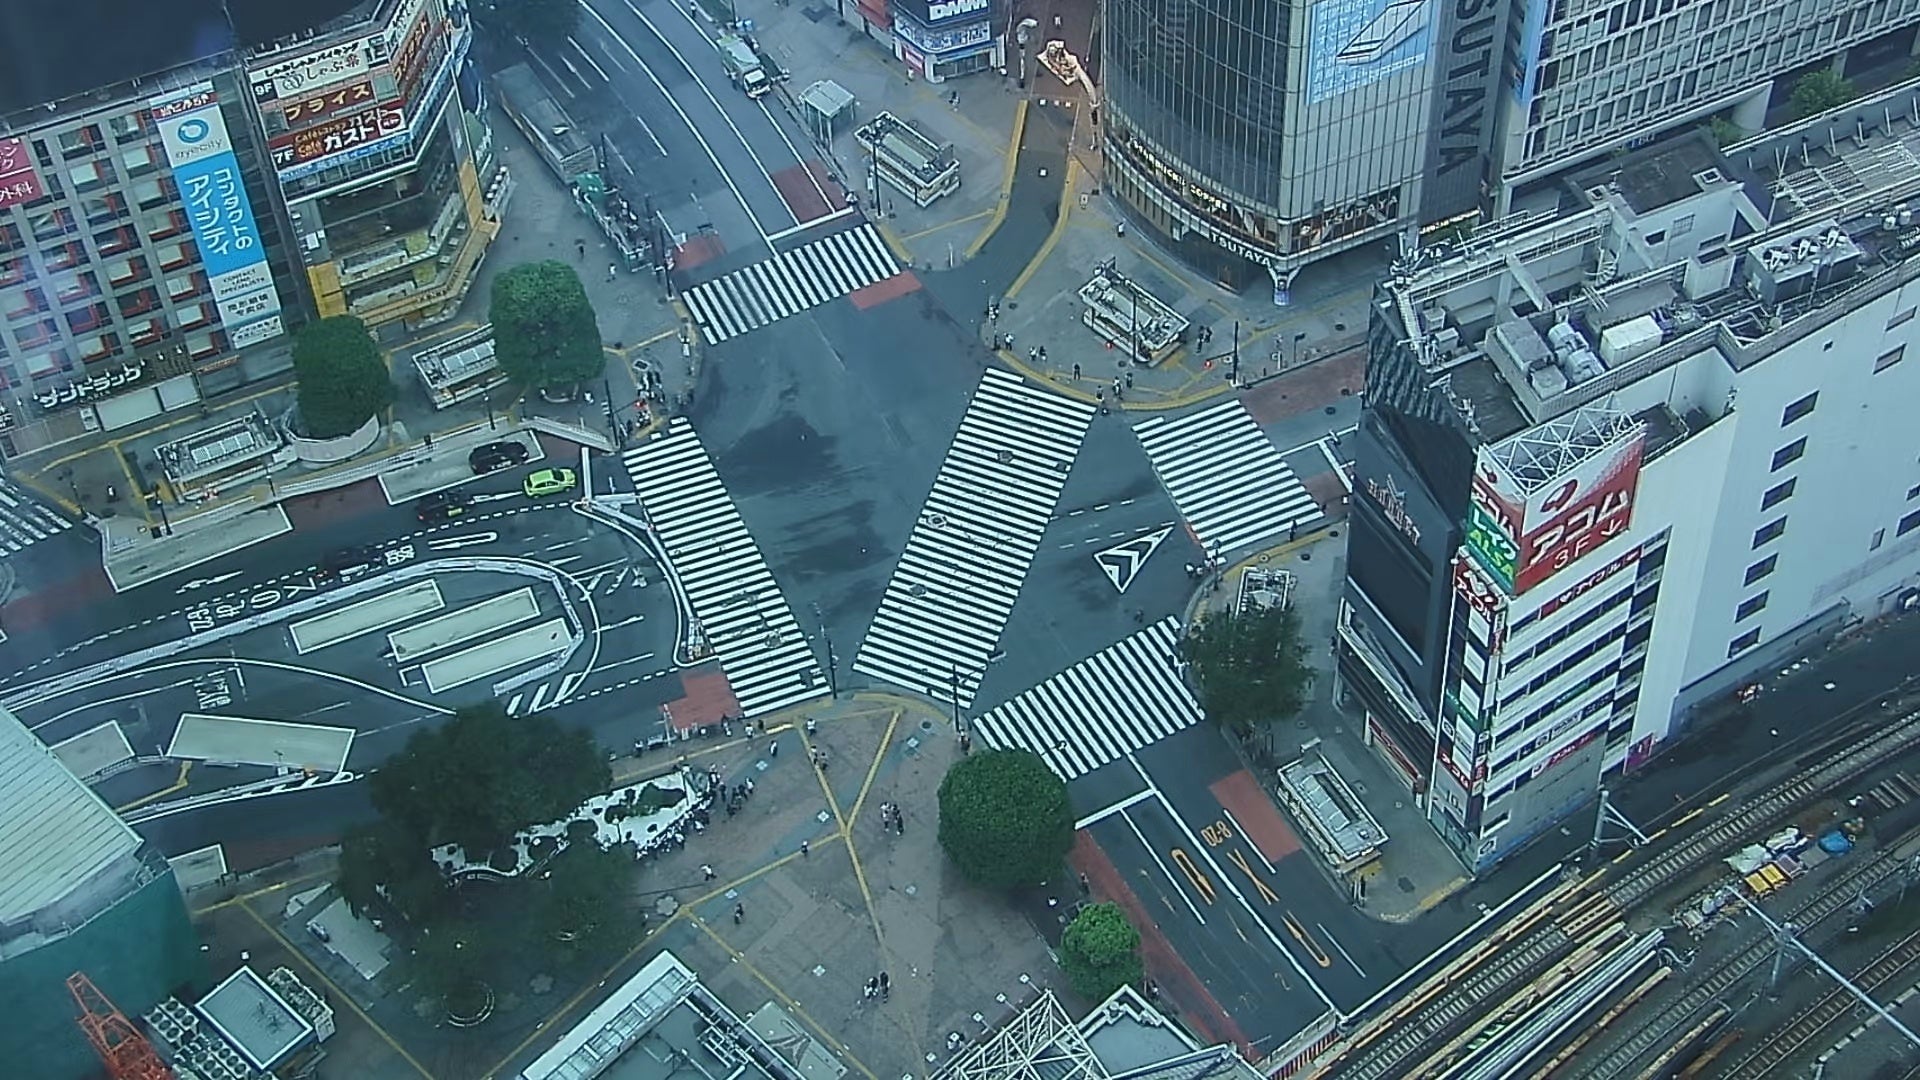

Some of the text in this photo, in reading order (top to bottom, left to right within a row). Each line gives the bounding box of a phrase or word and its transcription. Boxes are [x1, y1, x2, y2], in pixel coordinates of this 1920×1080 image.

[273, 149, 294, 165] 7F
[323, 126, 376, 152] ガスト
[183, 174, 230, 256] アイシティ
[1211, 231, 1272, 269] TSUTAYA
[1529, 490, 1629, 567] アコム
[1553, 533, 1592, 570] 3F
